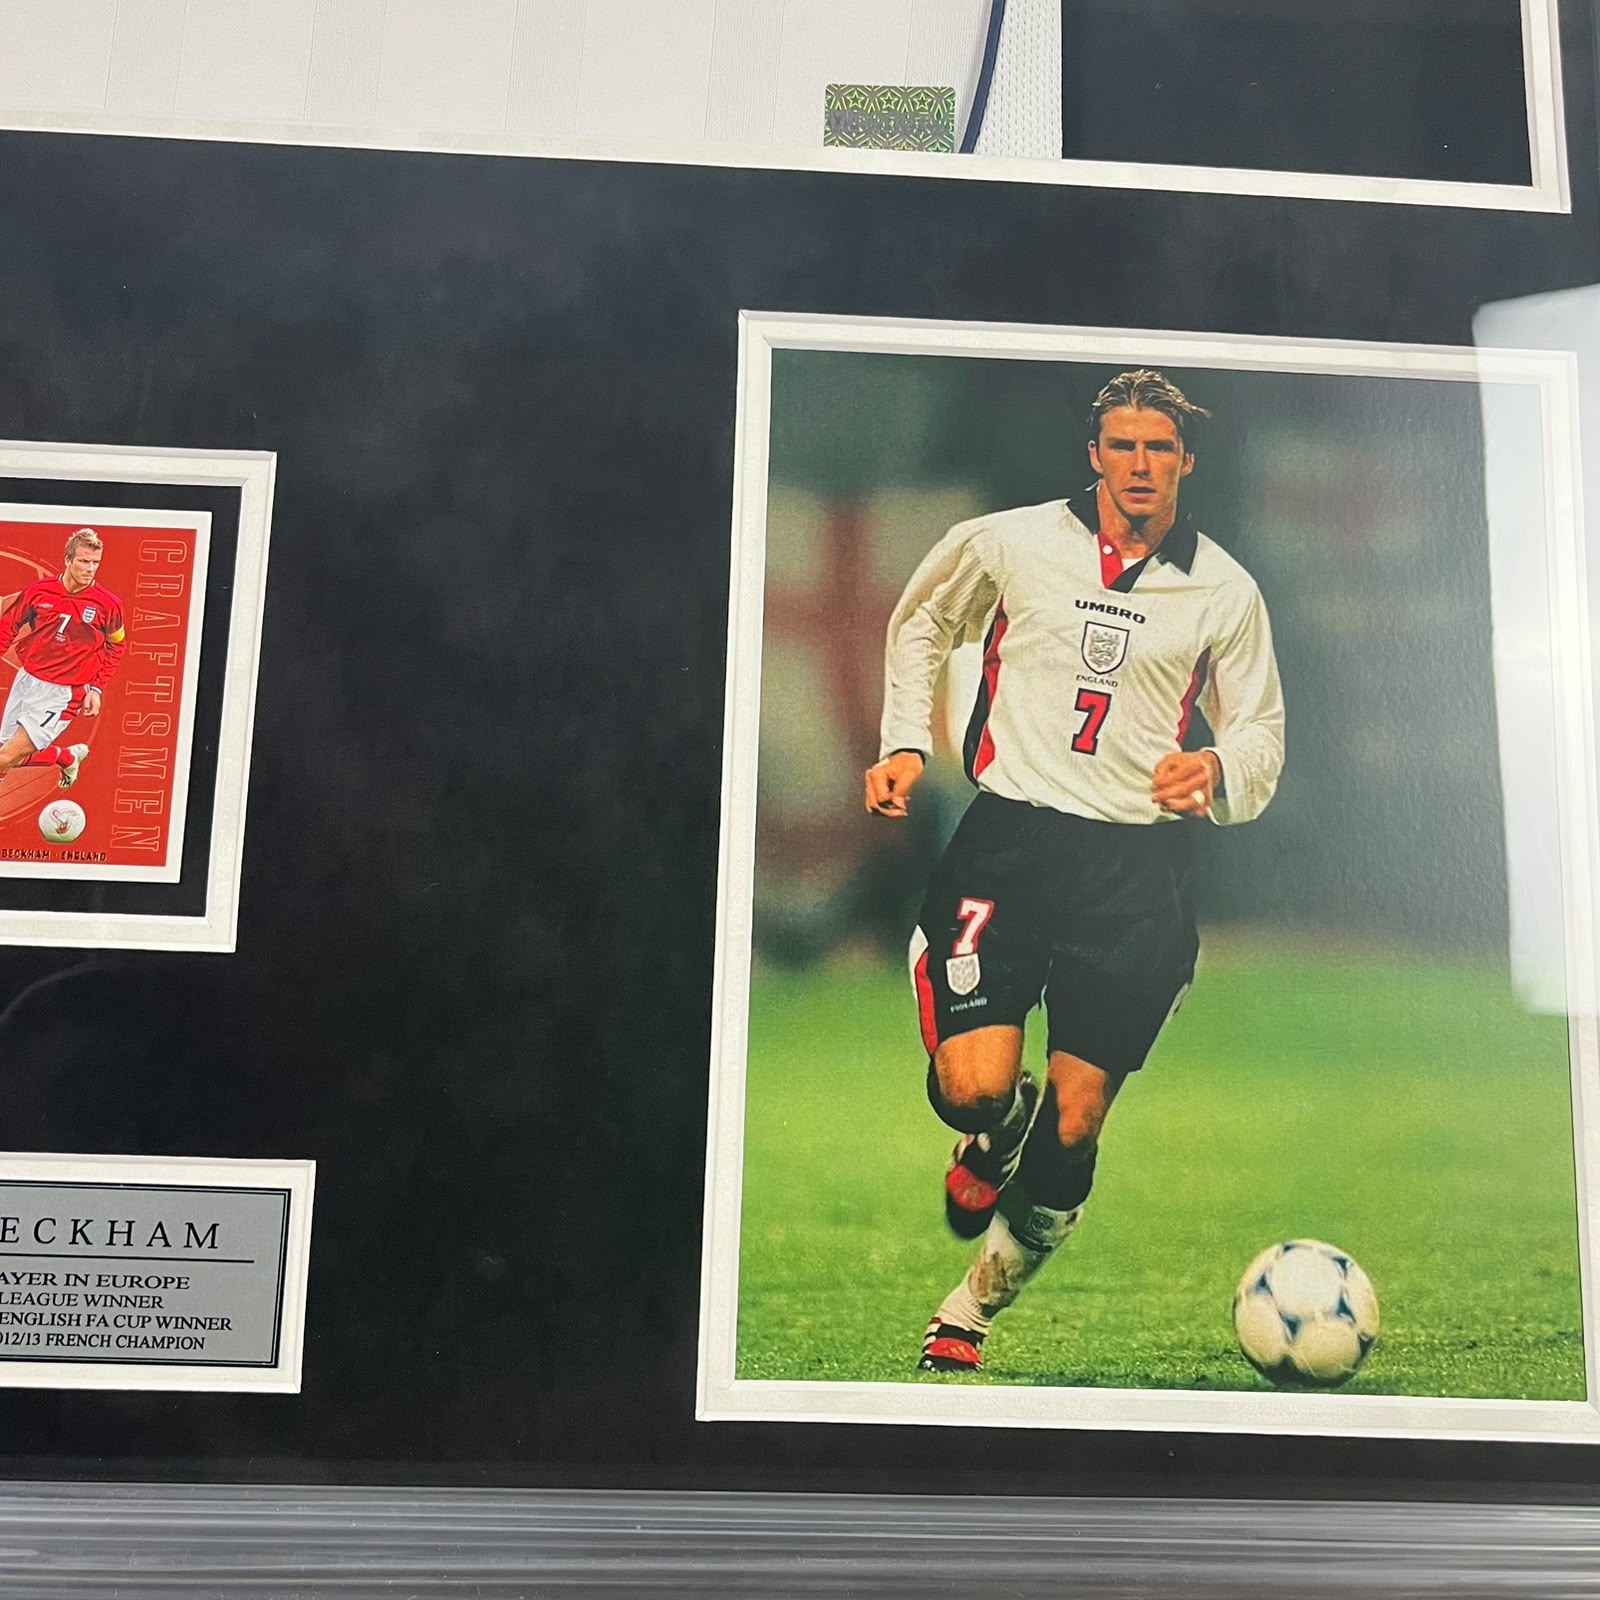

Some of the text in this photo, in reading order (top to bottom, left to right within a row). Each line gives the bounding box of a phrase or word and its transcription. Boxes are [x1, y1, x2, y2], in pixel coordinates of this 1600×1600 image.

[1075, 599, 1146, 625] UMBRO
[58, 613, 72, 634] 7
[1075, 674, 1119, 688] ENGLAND
[110, 538, 188, 852] CRAFTSMEN
[40, 710, 56, 727] 7
[1071, 687, 1112, 756] 7
[1, 848, 107, 861] BECKHAM ENGLAND
[952, 897, 995, 958] 7
[63, 1273, 91, 1287] IN
[95, 1274, 190, 1290] EUROPE
[0, 1291, 164, 1309] LEAGUE WINNER
[0, 1311, 233, 1331] ENGLISH FA CUP WINNER
[45, 1332, 112, 1348] FRENCH
[115, 1334, 206, 1350] CHAMPION
